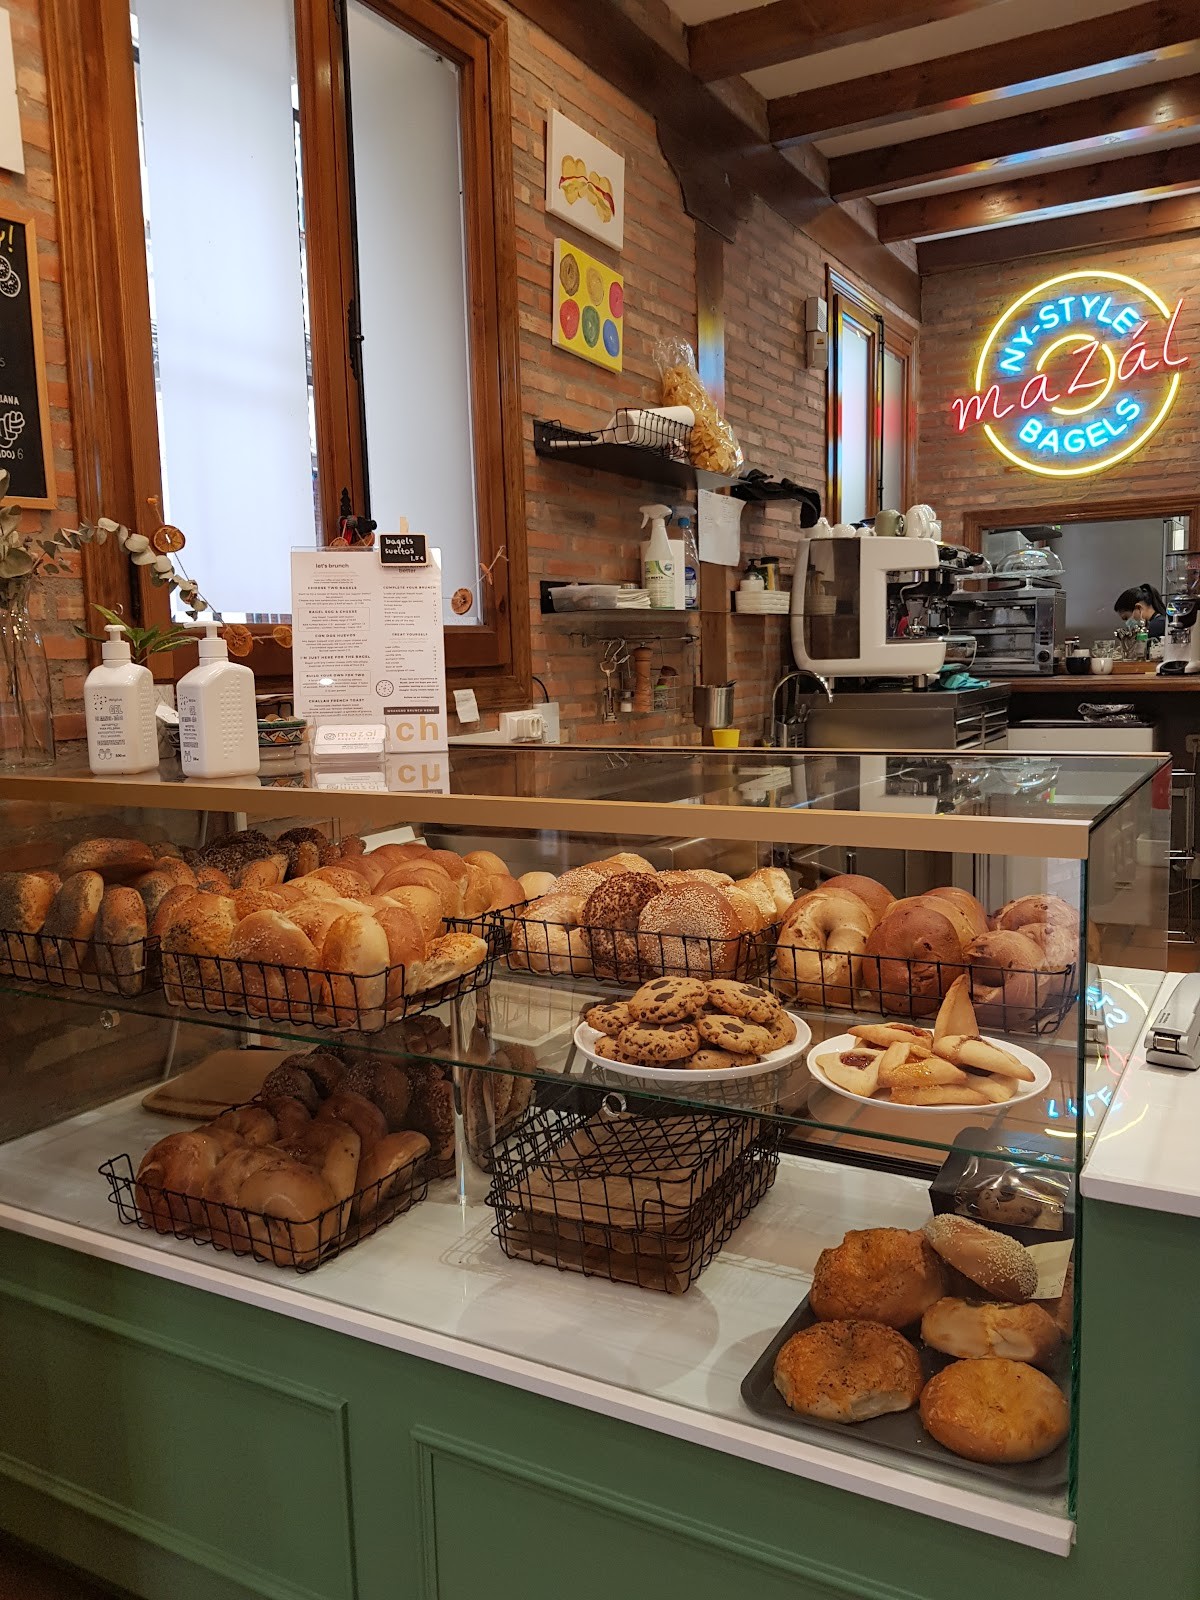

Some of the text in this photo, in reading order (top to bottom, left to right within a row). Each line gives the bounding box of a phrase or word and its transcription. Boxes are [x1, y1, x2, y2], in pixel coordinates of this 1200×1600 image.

[1000, 295, 1140, 372] NY-STYLE
[1018, 397, 1141, 453] BAGELS
[0, 450, 16, 460] DO)
[385, 537, 414, 549] bagels
[387, 716, 439, 741] ch
